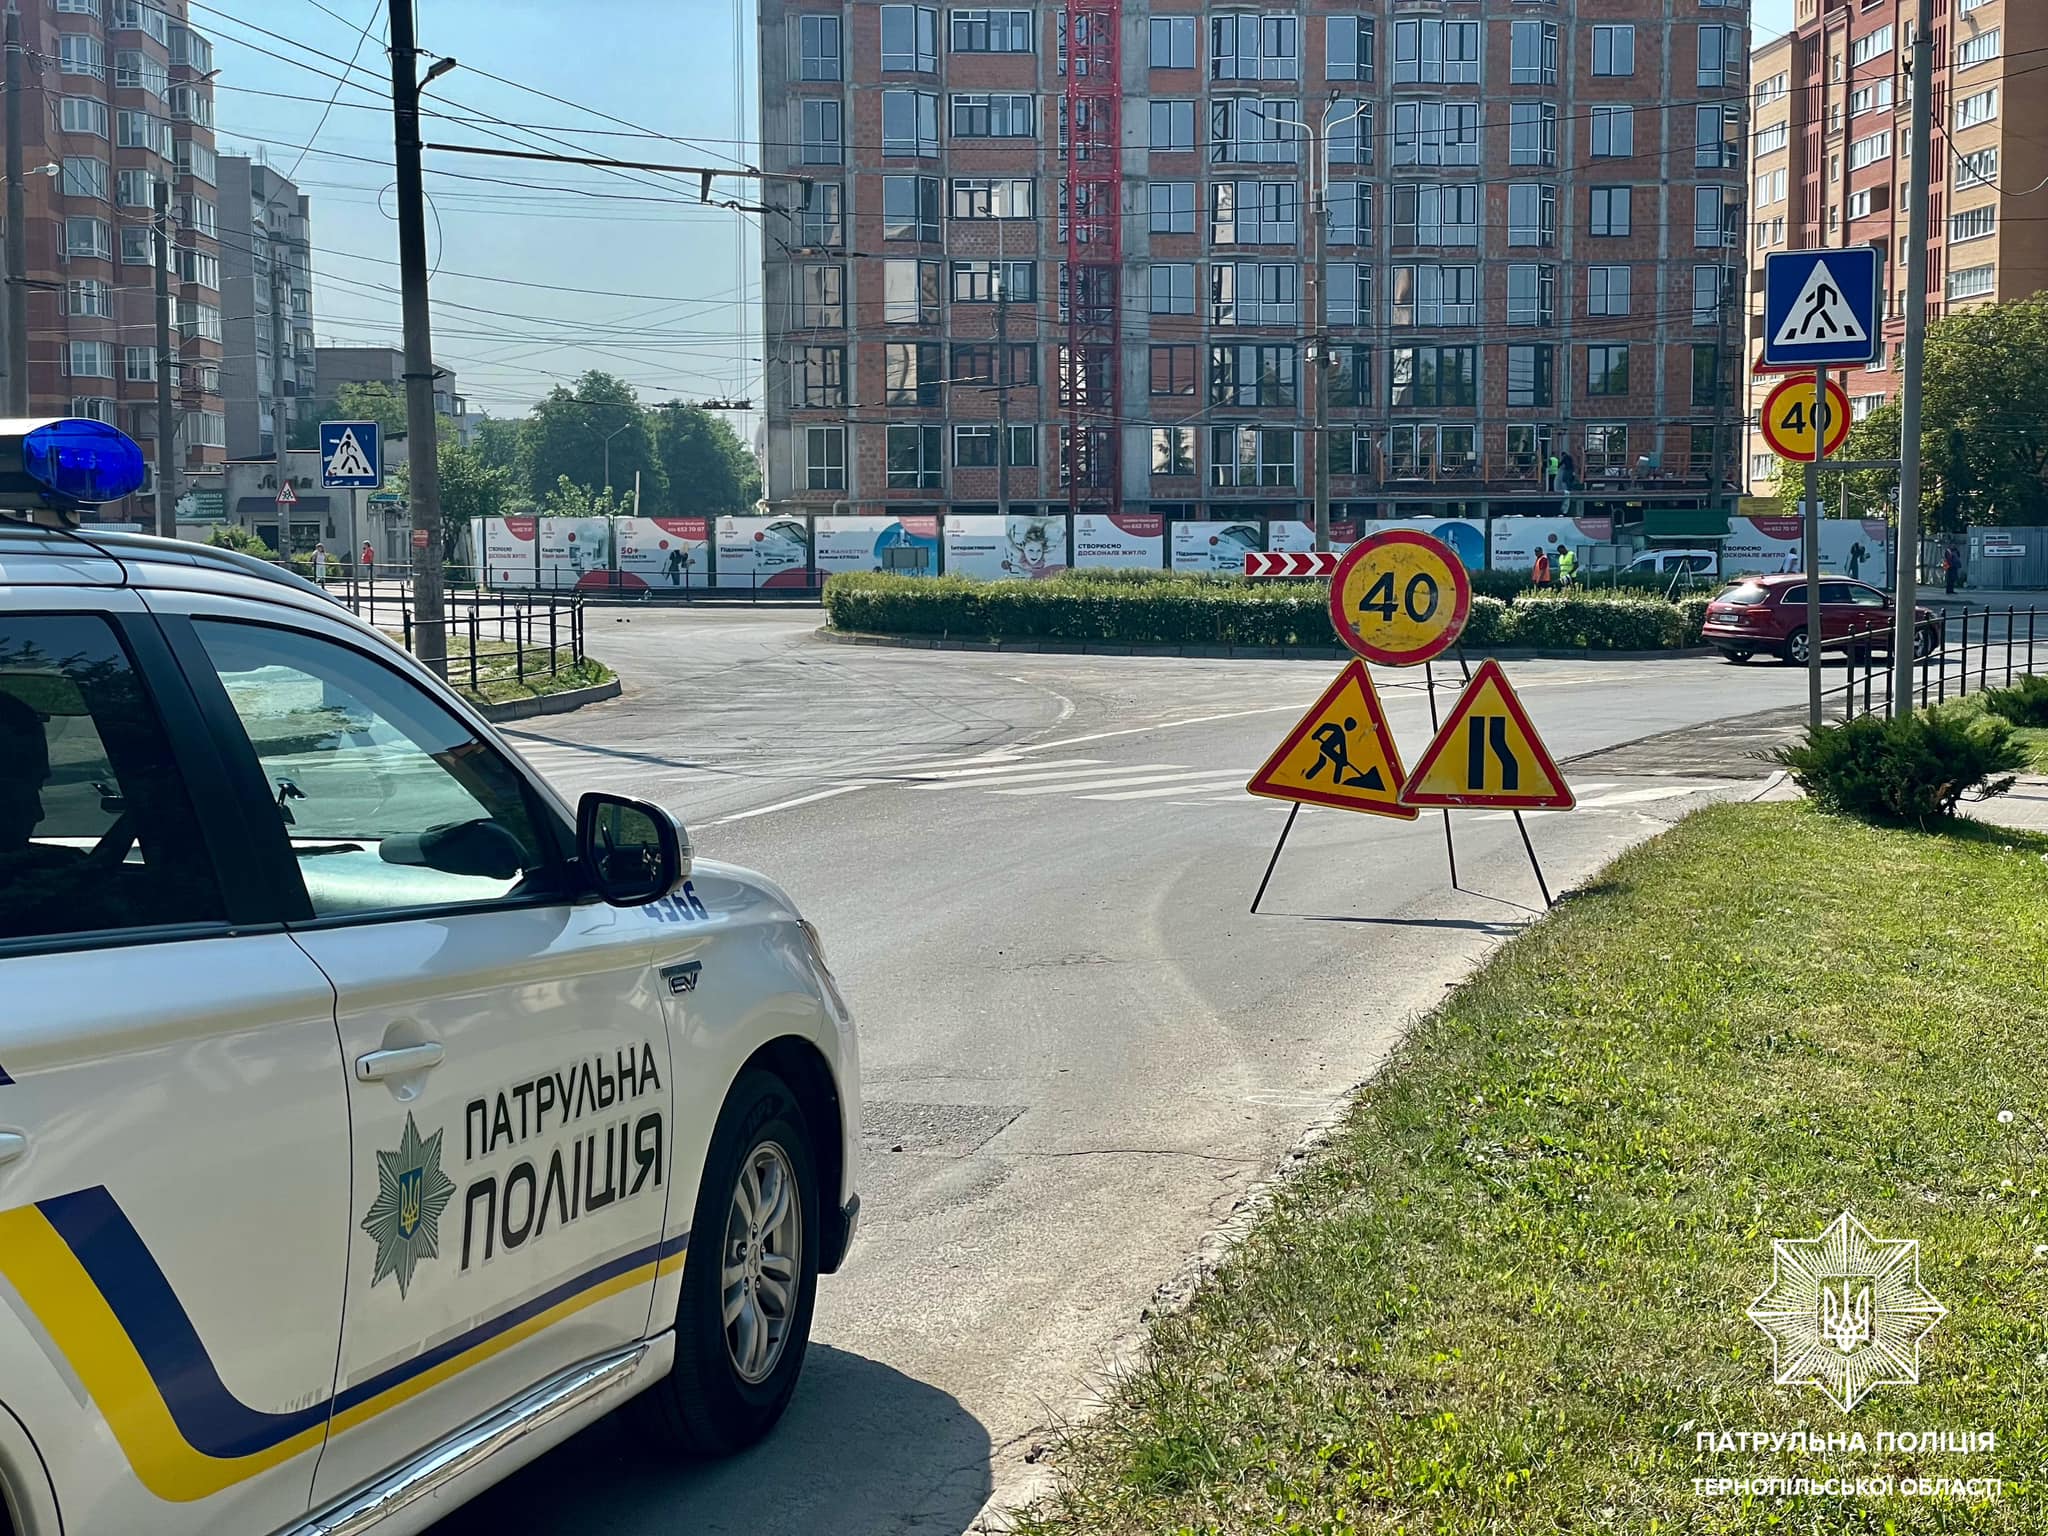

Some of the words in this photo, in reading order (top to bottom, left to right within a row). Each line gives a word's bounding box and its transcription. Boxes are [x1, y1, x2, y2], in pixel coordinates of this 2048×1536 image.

[1780, 401, 1832, 435] 40
[1359, 571, 1439, 624] 40
[465, 1041, 662, 1161] ПАТРУЛЬНА
[460, 1111, 663, 1272] ПОЛІЦІЯ
